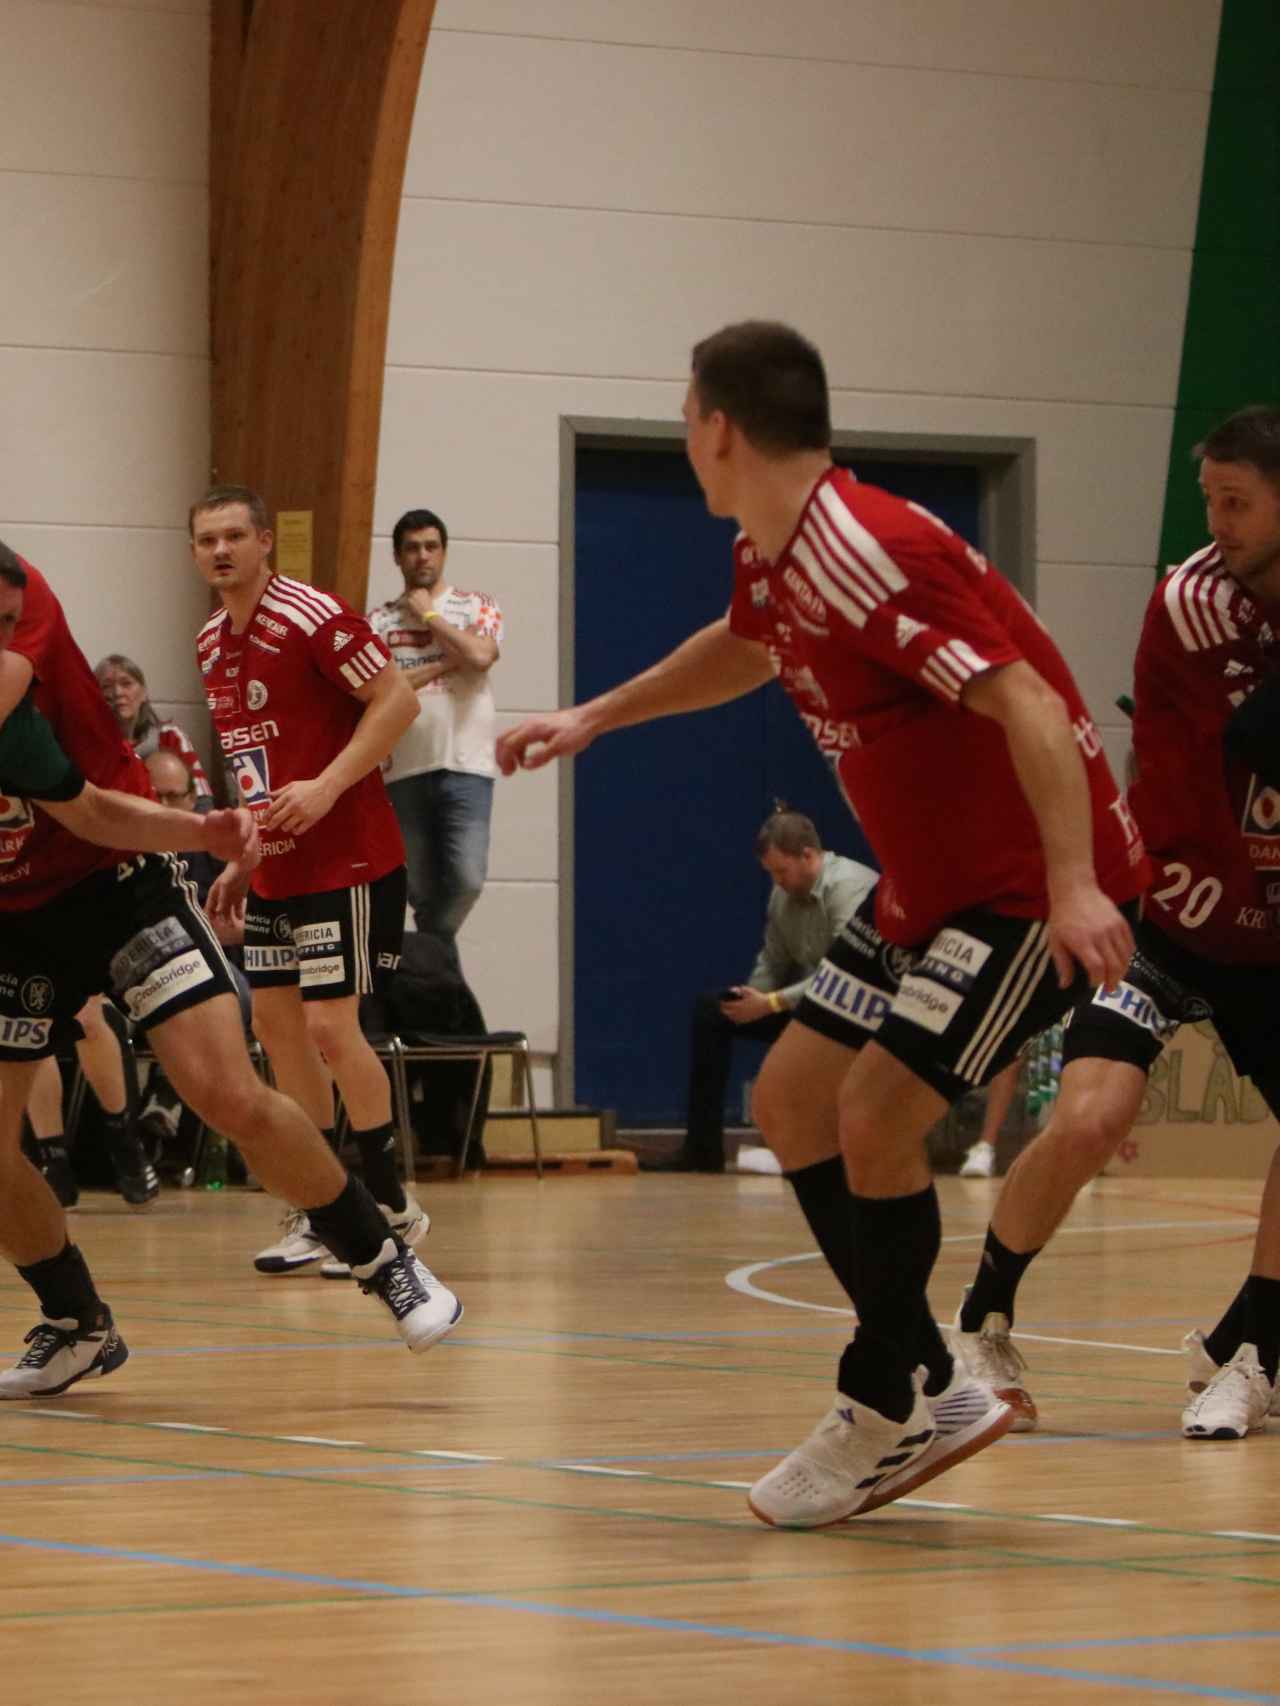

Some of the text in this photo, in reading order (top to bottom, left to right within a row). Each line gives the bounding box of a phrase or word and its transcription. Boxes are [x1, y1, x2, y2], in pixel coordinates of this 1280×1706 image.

[1151, 862, 1223, 929] 20
[245, 948, 297, 968] HILIP
[811, 965, 893, 1021] HILIP
